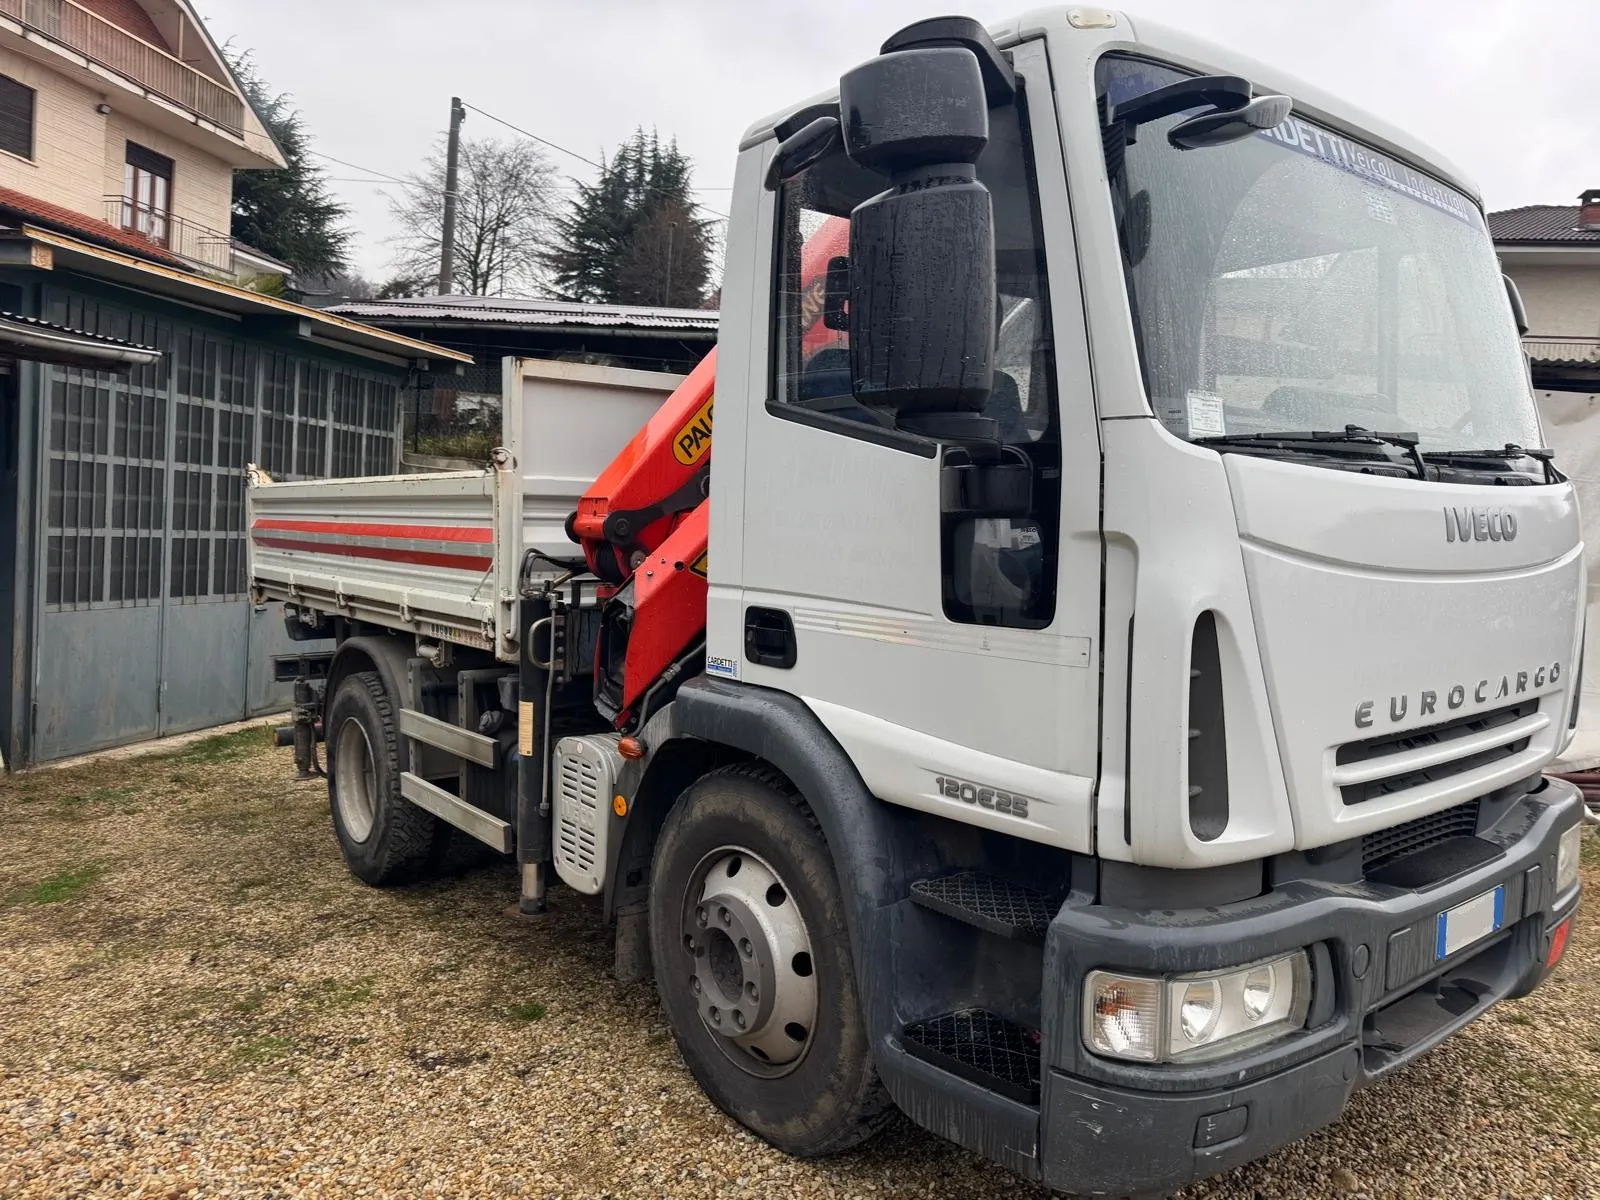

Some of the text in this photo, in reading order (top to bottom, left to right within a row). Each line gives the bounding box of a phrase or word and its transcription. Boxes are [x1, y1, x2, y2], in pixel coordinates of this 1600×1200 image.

[1443, 506, 1518, 542] IVECO
[1355, 662, 1560, 728] EUROCARGO
[935, 776, 1028, 818] 120E25
